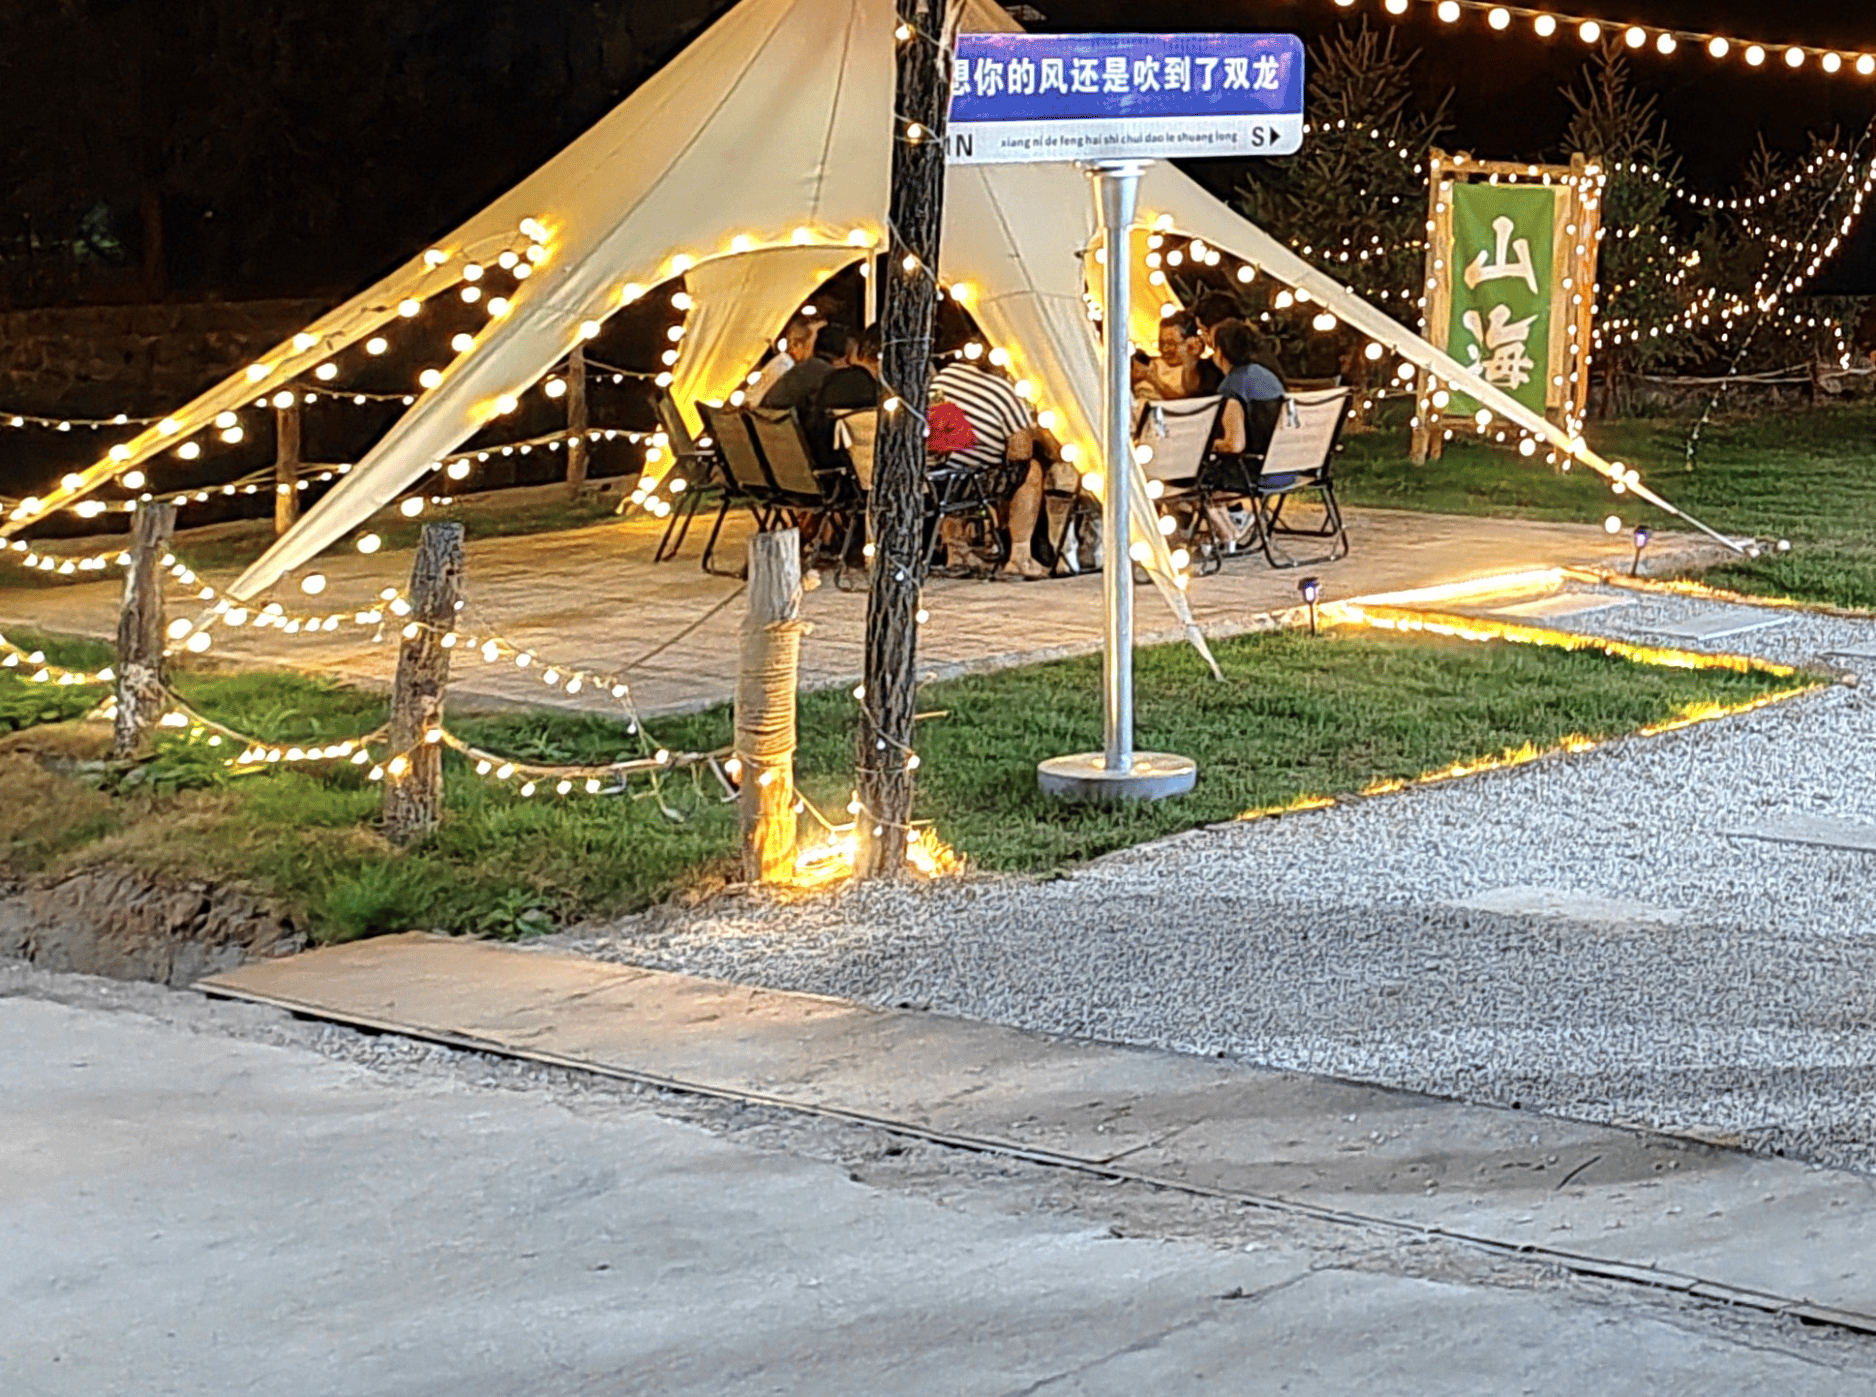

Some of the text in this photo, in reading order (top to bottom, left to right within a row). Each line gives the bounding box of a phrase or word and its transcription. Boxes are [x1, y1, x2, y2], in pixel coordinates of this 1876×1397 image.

[956, 133, 972, 157] N
[1251, 127, 1265, 148] S
[1462, 215, 1540, 390] 山海
